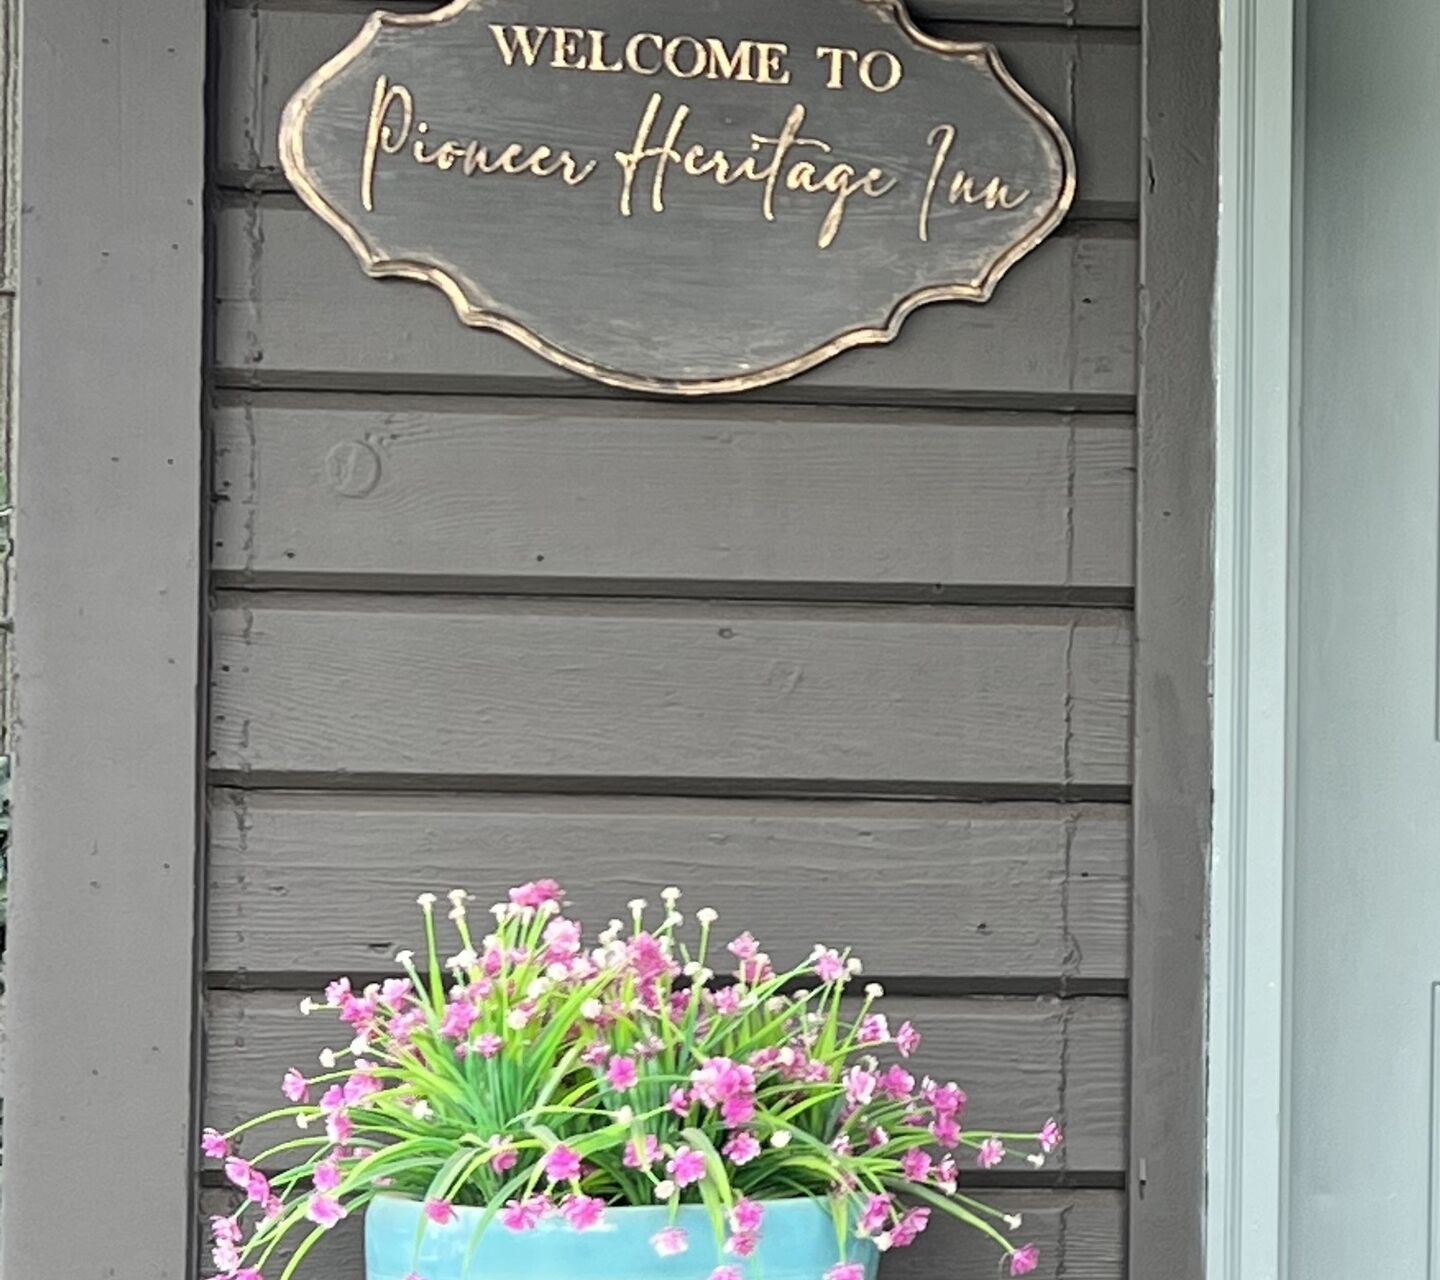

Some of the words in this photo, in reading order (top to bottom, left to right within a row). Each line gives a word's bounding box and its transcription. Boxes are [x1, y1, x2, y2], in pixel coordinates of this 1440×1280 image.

[488, 23, 791, 86] WELCOME
[816, 46, 904, 94] TO
[361, 75, 599, 212] Pioneer
[614, 93, 898, 249] Heritage
[919, 124, 1032, 241] Inn
